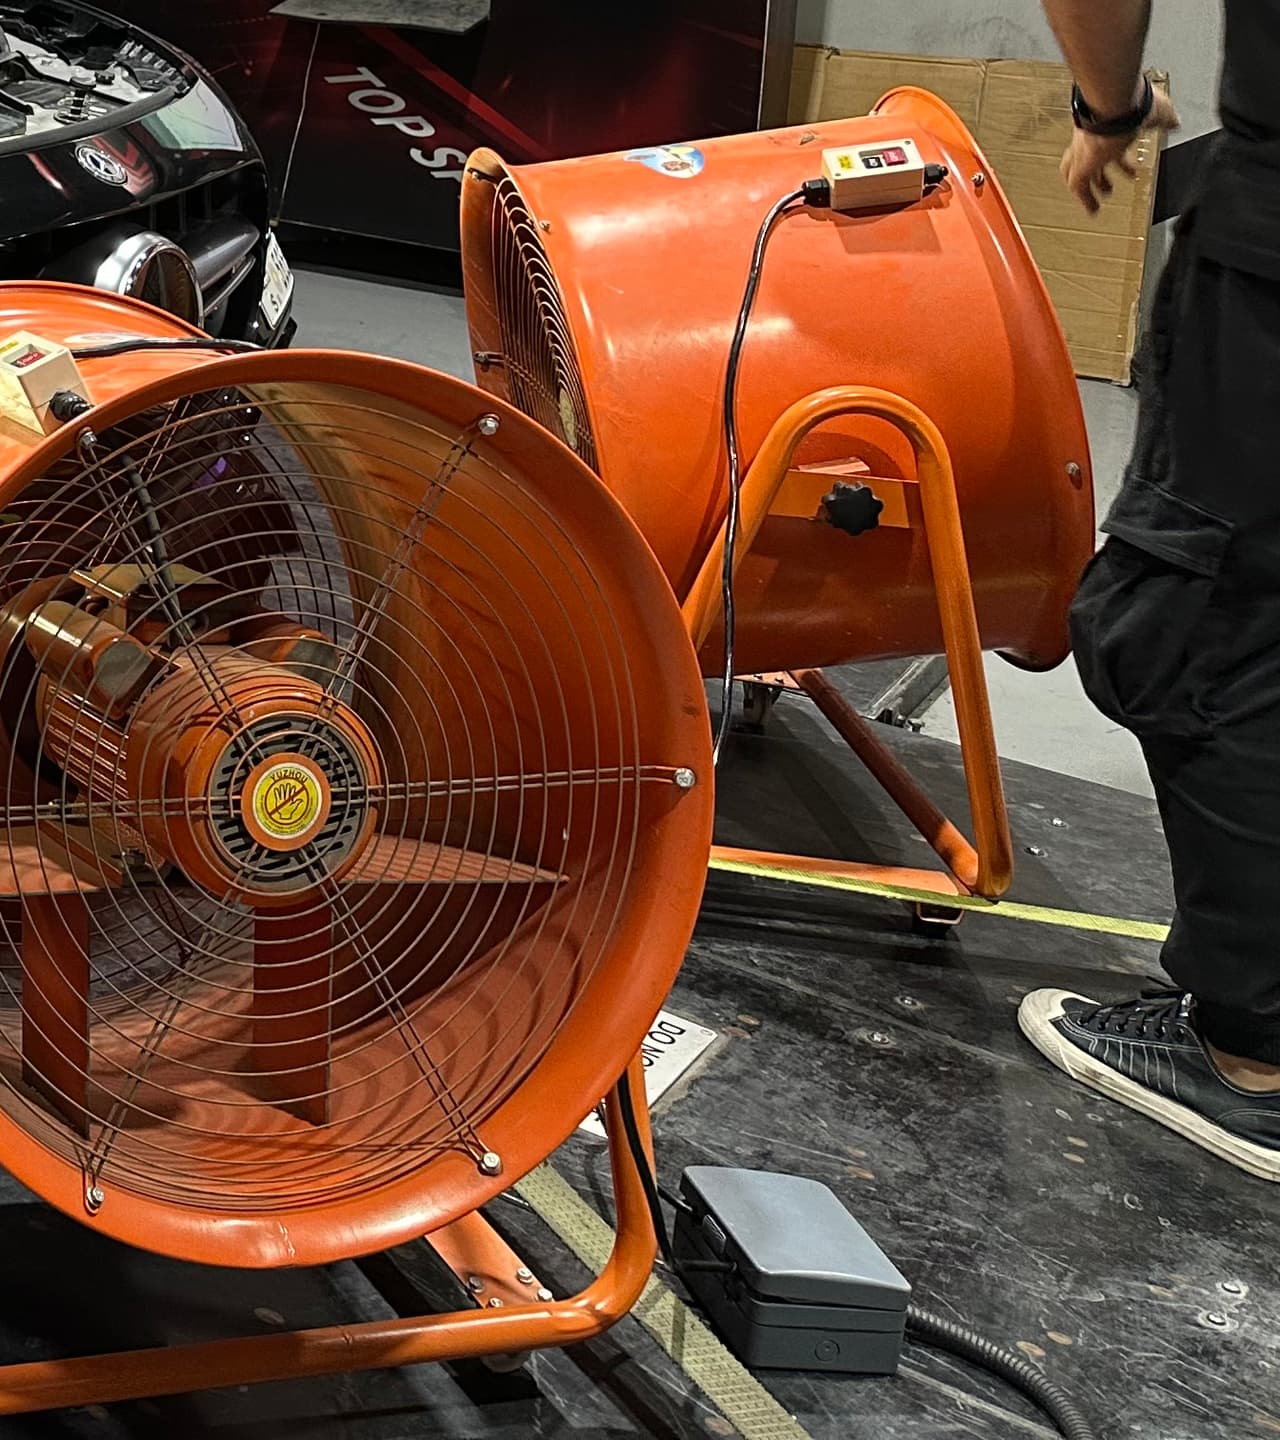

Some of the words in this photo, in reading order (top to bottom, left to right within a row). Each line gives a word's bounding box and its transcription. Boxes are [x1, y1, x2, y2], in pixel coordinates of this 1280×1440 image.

[323, 67, 435, 137] TOP
[271, 769, 309, 783] YUZHOU
[648, 1020, 687, 1045] DO
